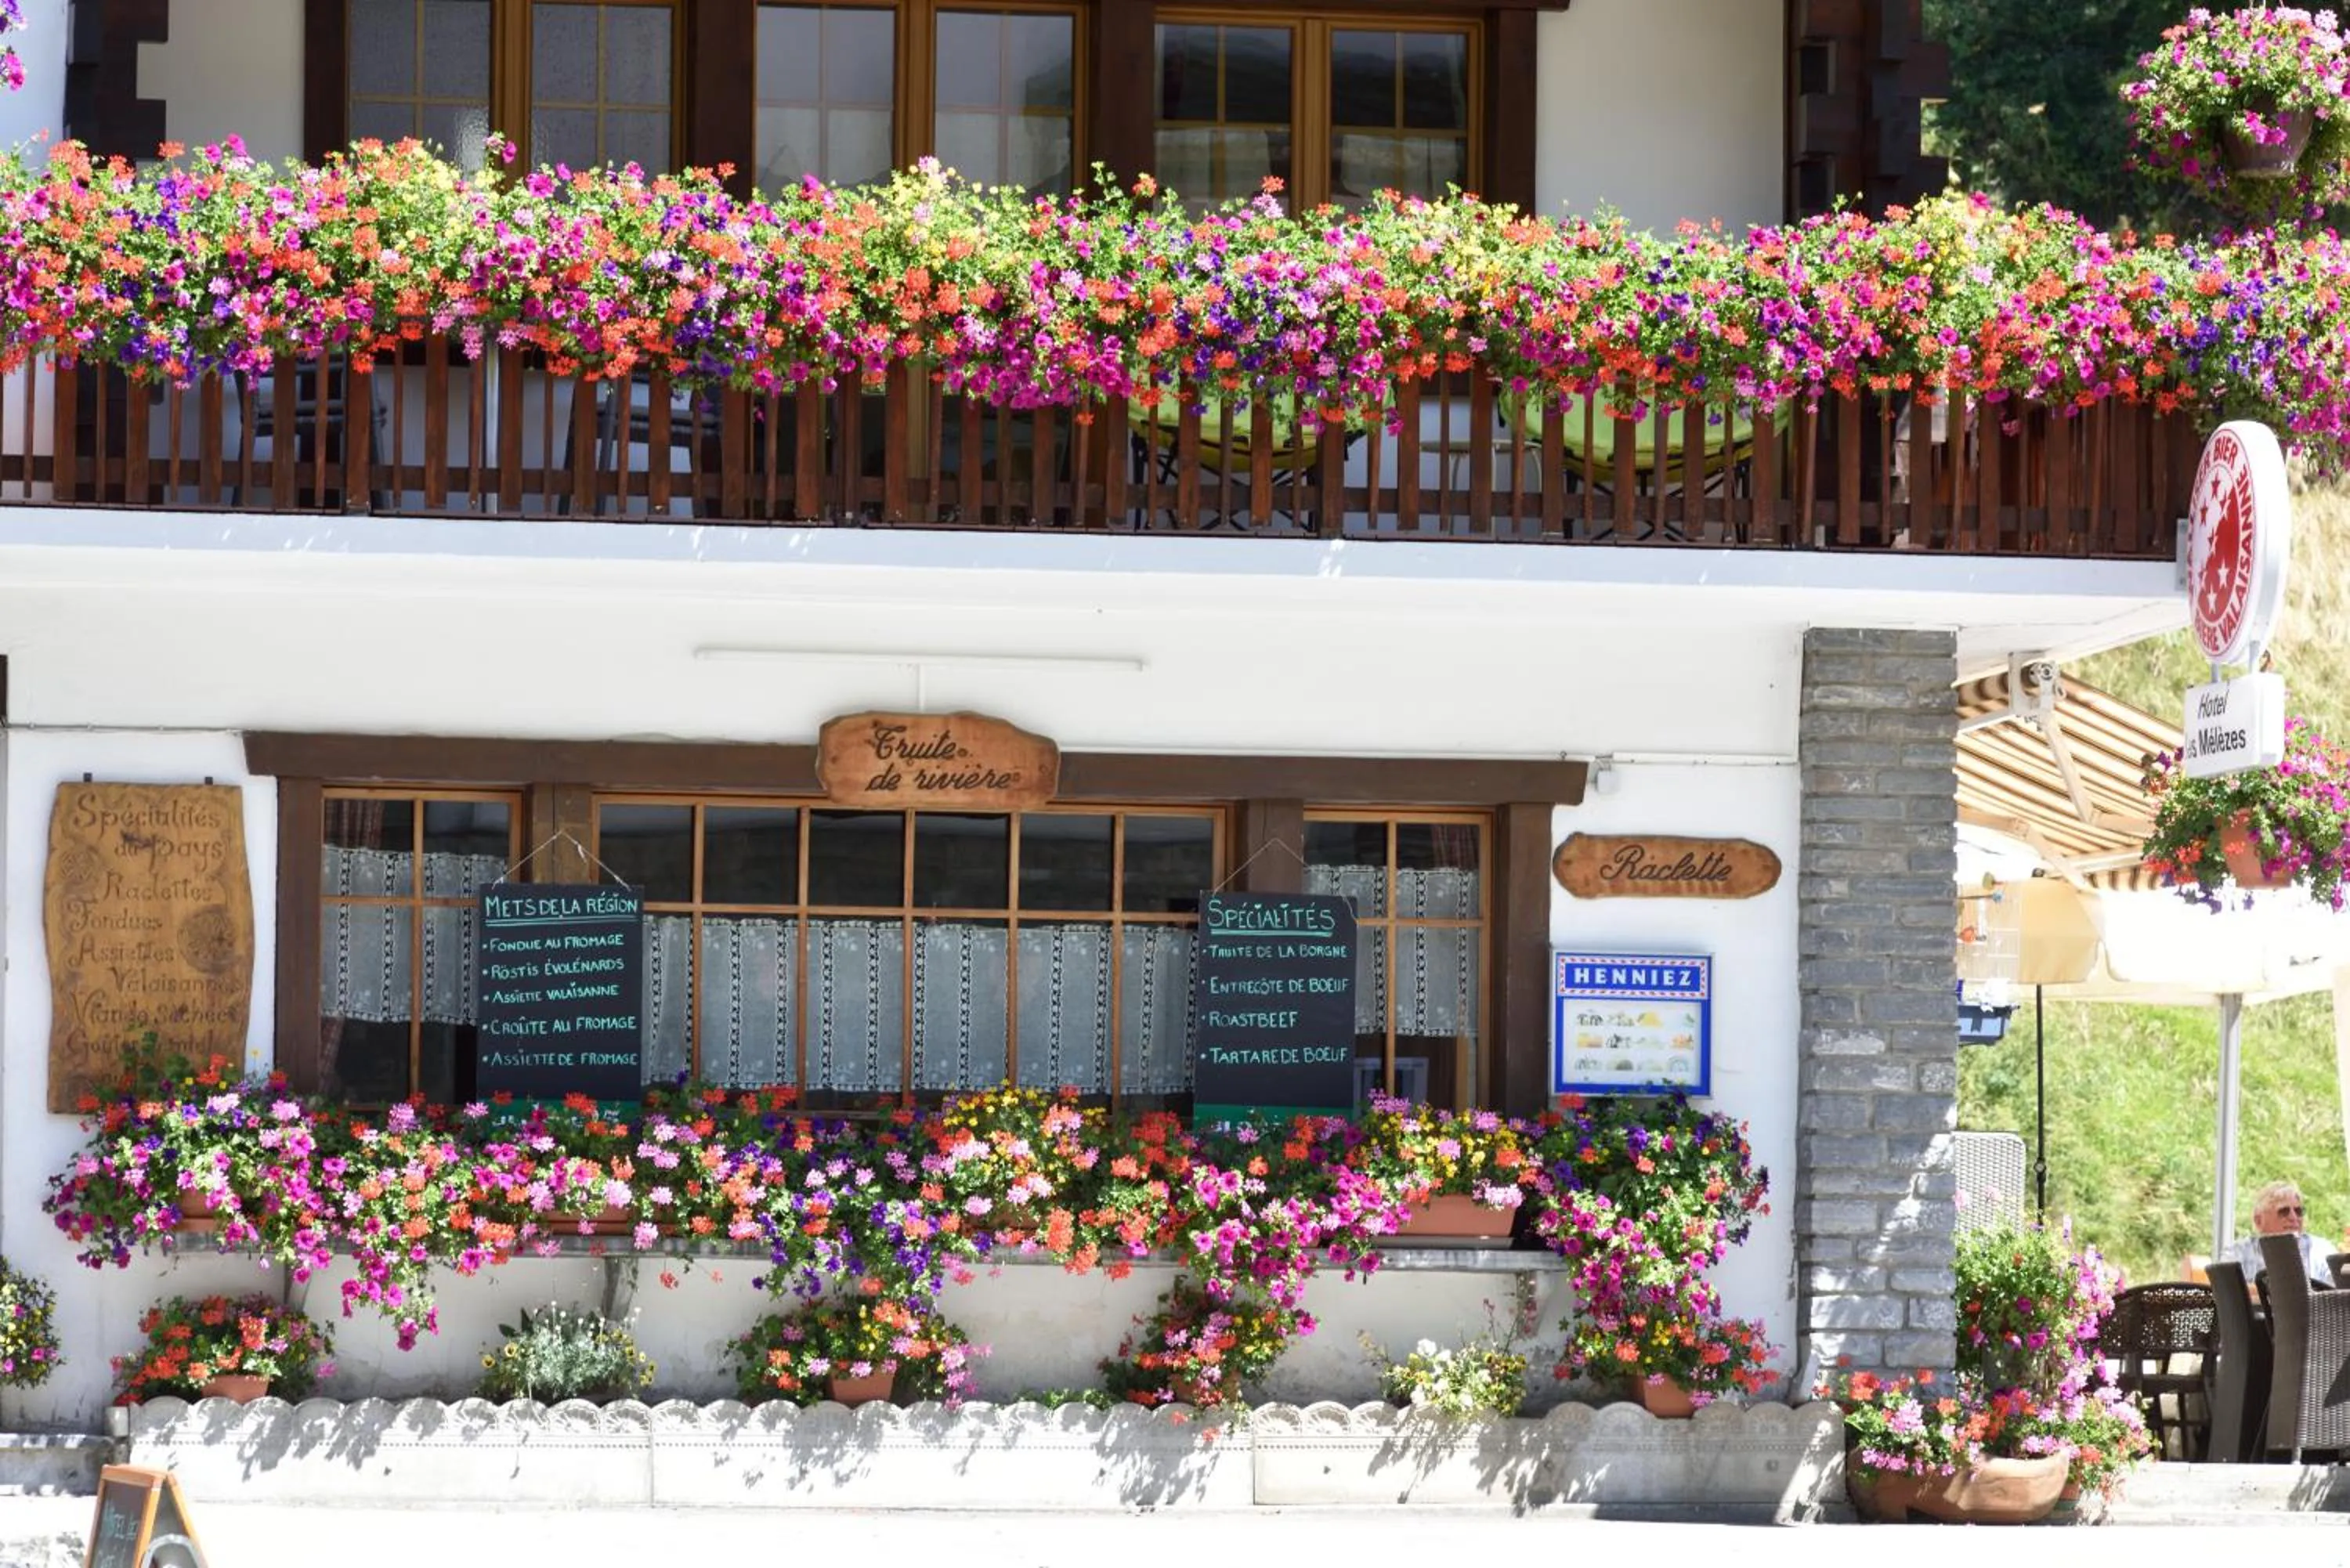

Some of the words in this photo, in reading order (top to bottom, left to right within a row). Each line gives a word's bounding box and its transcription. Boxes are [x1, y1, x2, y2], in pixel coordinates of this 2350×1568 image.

[2213, 435, 2239, 470] BIER
[2218, 463, 2254, 645] VALAISANNE
[873, 724, 956, 761] Truite
[2198, 727, 2247, 757] Mélèzes
[864, 761, 902, 792] de
[914, 764, 1014, 791] rivière
[73, 793, 222, 841] Spécialités
[1599, 844, 1734, 882] Raclette
[67, 898, 163, 933] Fondues
[486, 896, 537, 917] METS
[539, 900, 559, 916] DE
[562, 898, 580, 915] LA
[586, 891, 638, 913] RÉGION
[1207, 899, 1336, 930] SPÉCIALITÉS
[490, 938, 541, 952] FONDUE
[545, 938, 561, 949] AU
[564, 934, 624, 950] FROMAGE
[1256, 946, 1273, 959] DE
[1278, 945, 1295, 958] LA
[1300, 945, 1348, 958] BORGNE
[1210, 976, 1284, 995] ENTRECÔTE
[1289, 978, 1305, 992] DE
[1574, 967, 1693, 986] HENNIEZ
[490, 1016, 548, 1035] CROÛTE
[552, 1020, 571, 1033] AU
[576, 1016, 637, 1030] FROMAGE
[1209, 1011, 1298, 1028] ROASTBEEF
[558, 1053, 575, 1066] DE
[580, 1053, 638, 1066] FROMAGE
[1209, 1047, 1279, 1064] TARTARE
[1281, 1049, 1300, 1064] DE
